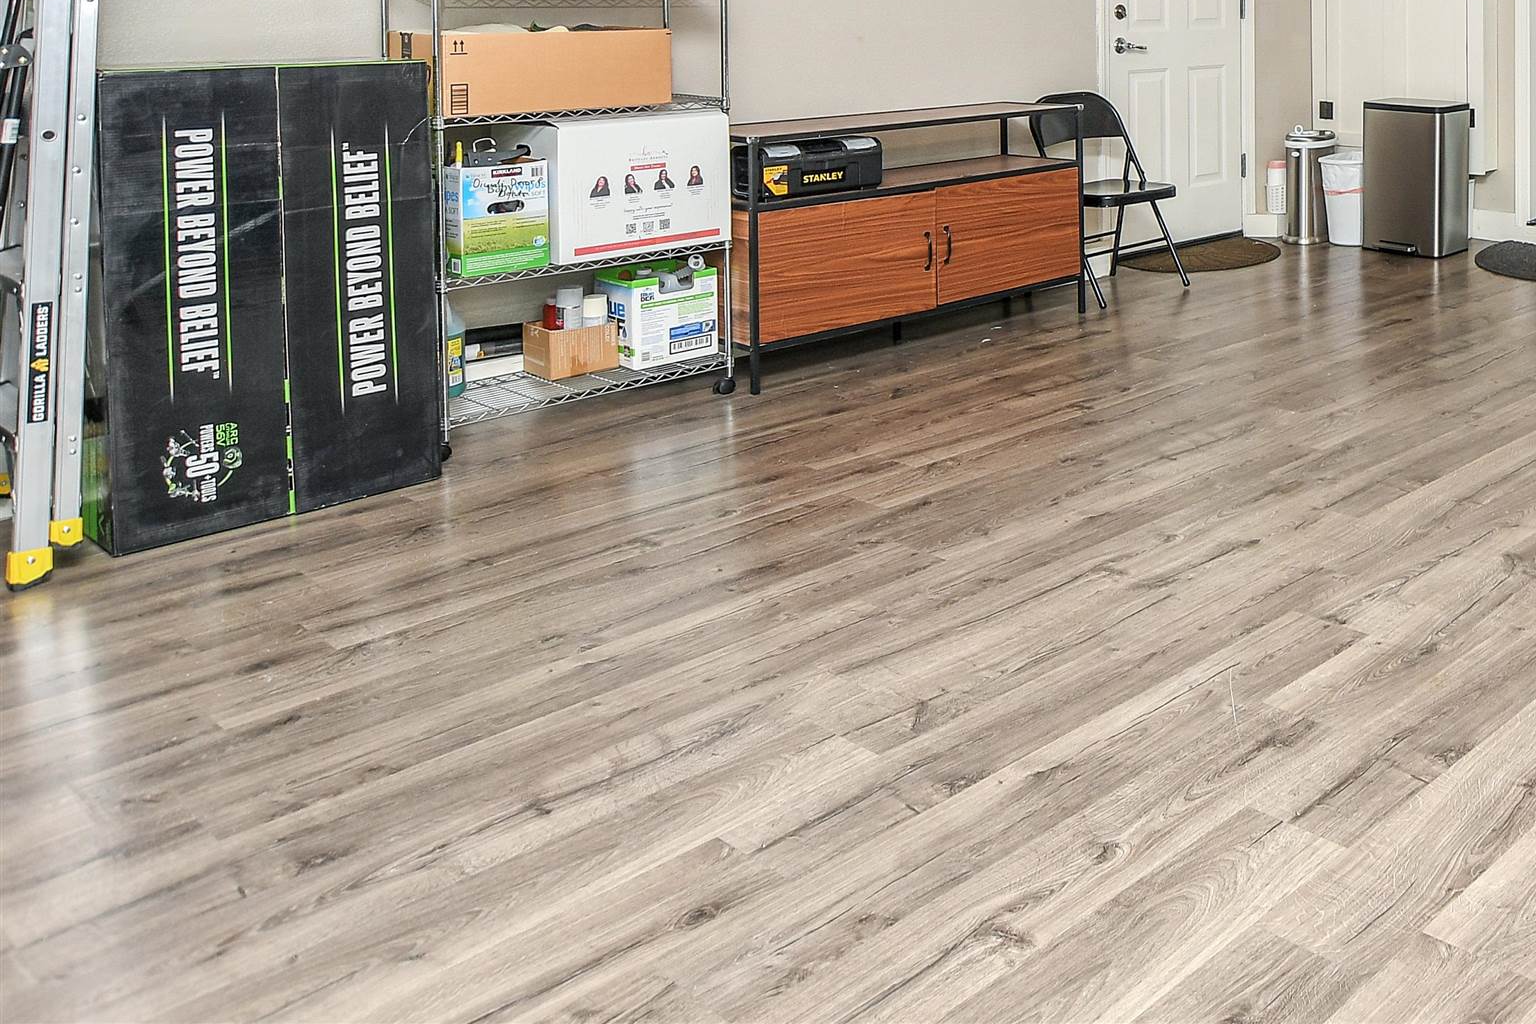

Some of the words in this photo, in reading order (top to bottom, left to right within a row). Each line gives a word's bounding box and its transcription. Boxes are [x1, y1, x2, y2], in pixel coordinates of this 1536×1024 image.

[173, 127, 215, 210] POWER
[803, 172, 843, 183] STANLEY
[175, 212, 217, 301] BEYOND
[344, 224, 384, 313] BEYOND
[36, 305, 49, 356] LADDERS
[348, 315, 388, 398] POWER
[32, 374, 46, 421] GORILLA
[199, 423, 215, 454] POWERS
[215, 423, 226, 447] 56V
[230, 422, 240, 445] ARC
[200, 477, 217, 503] TOOLS
